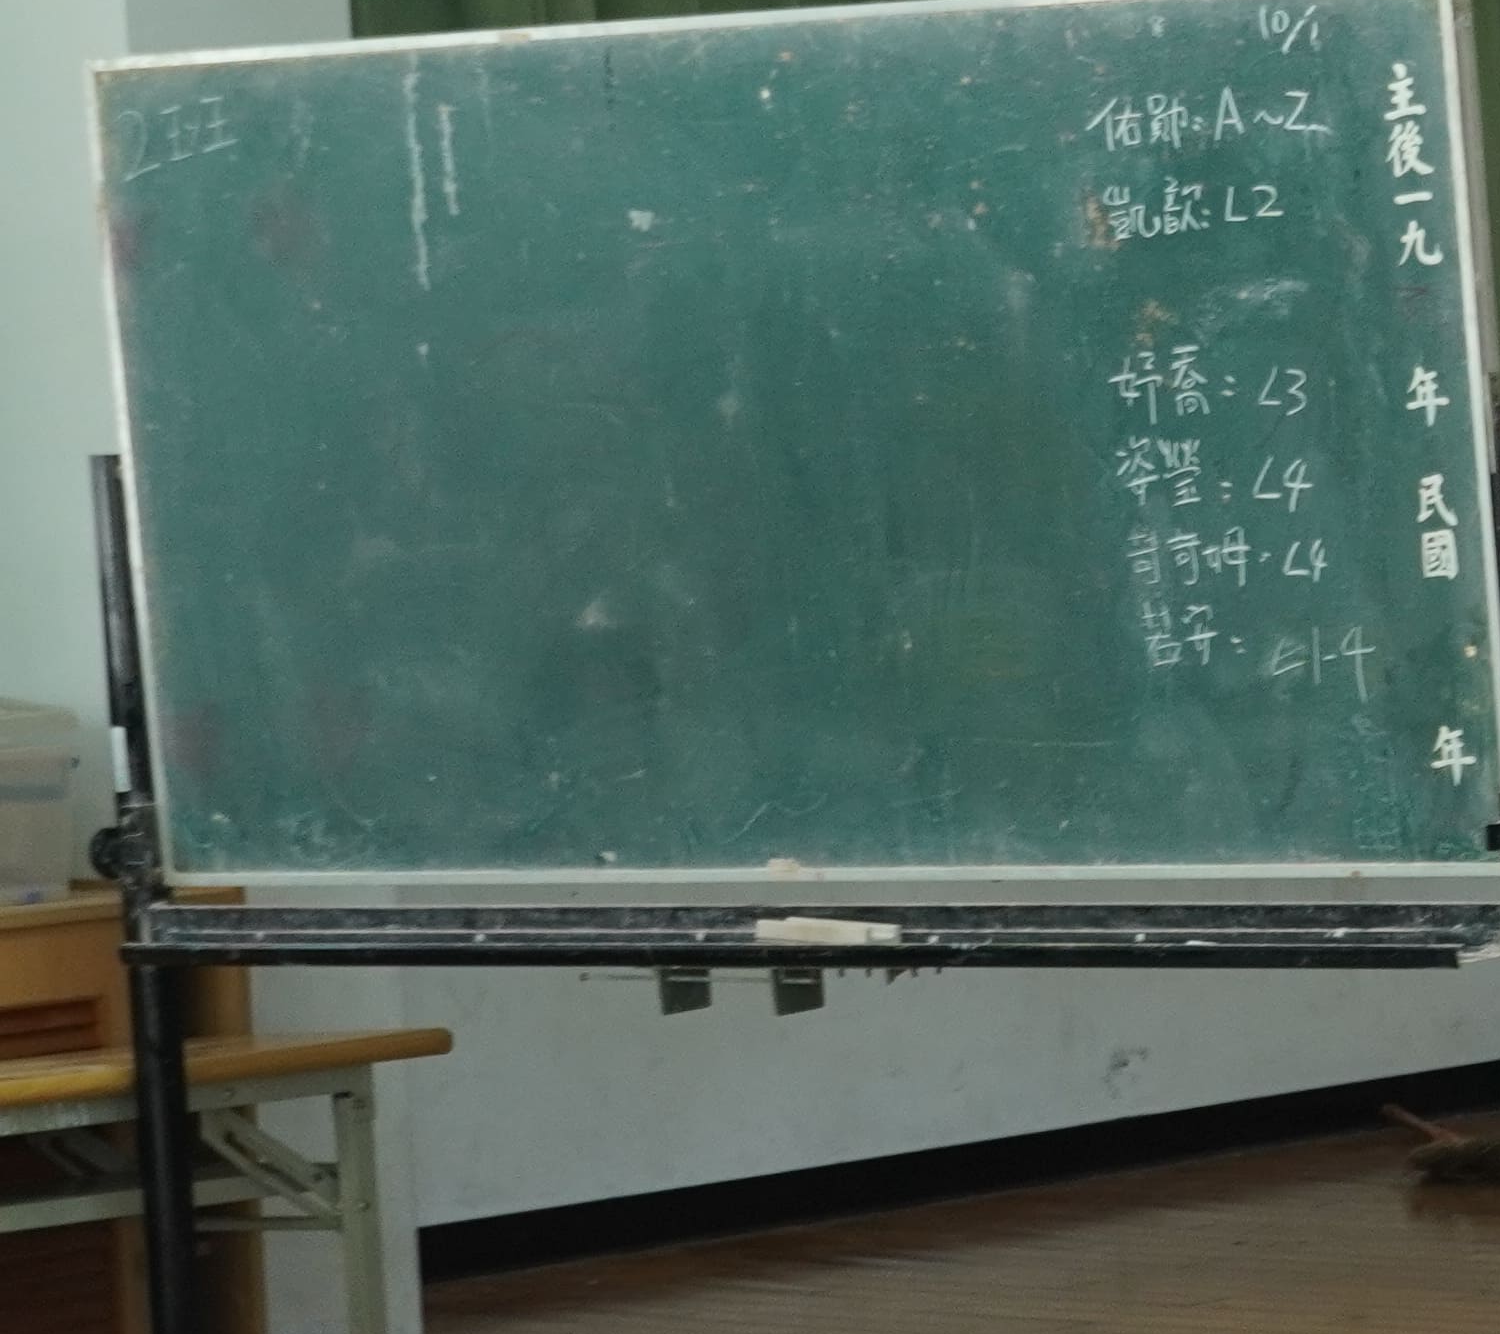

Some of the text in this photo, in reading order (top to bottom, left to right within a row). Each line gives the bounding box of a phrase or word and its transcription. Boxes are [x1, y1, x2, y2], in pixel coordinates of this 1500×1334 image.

[1258, 367, 1308, 416] L3
[1384, 63, 1477, 786] 主後一九 年 民國 年
[1253, 456, 1314, 512] L4
